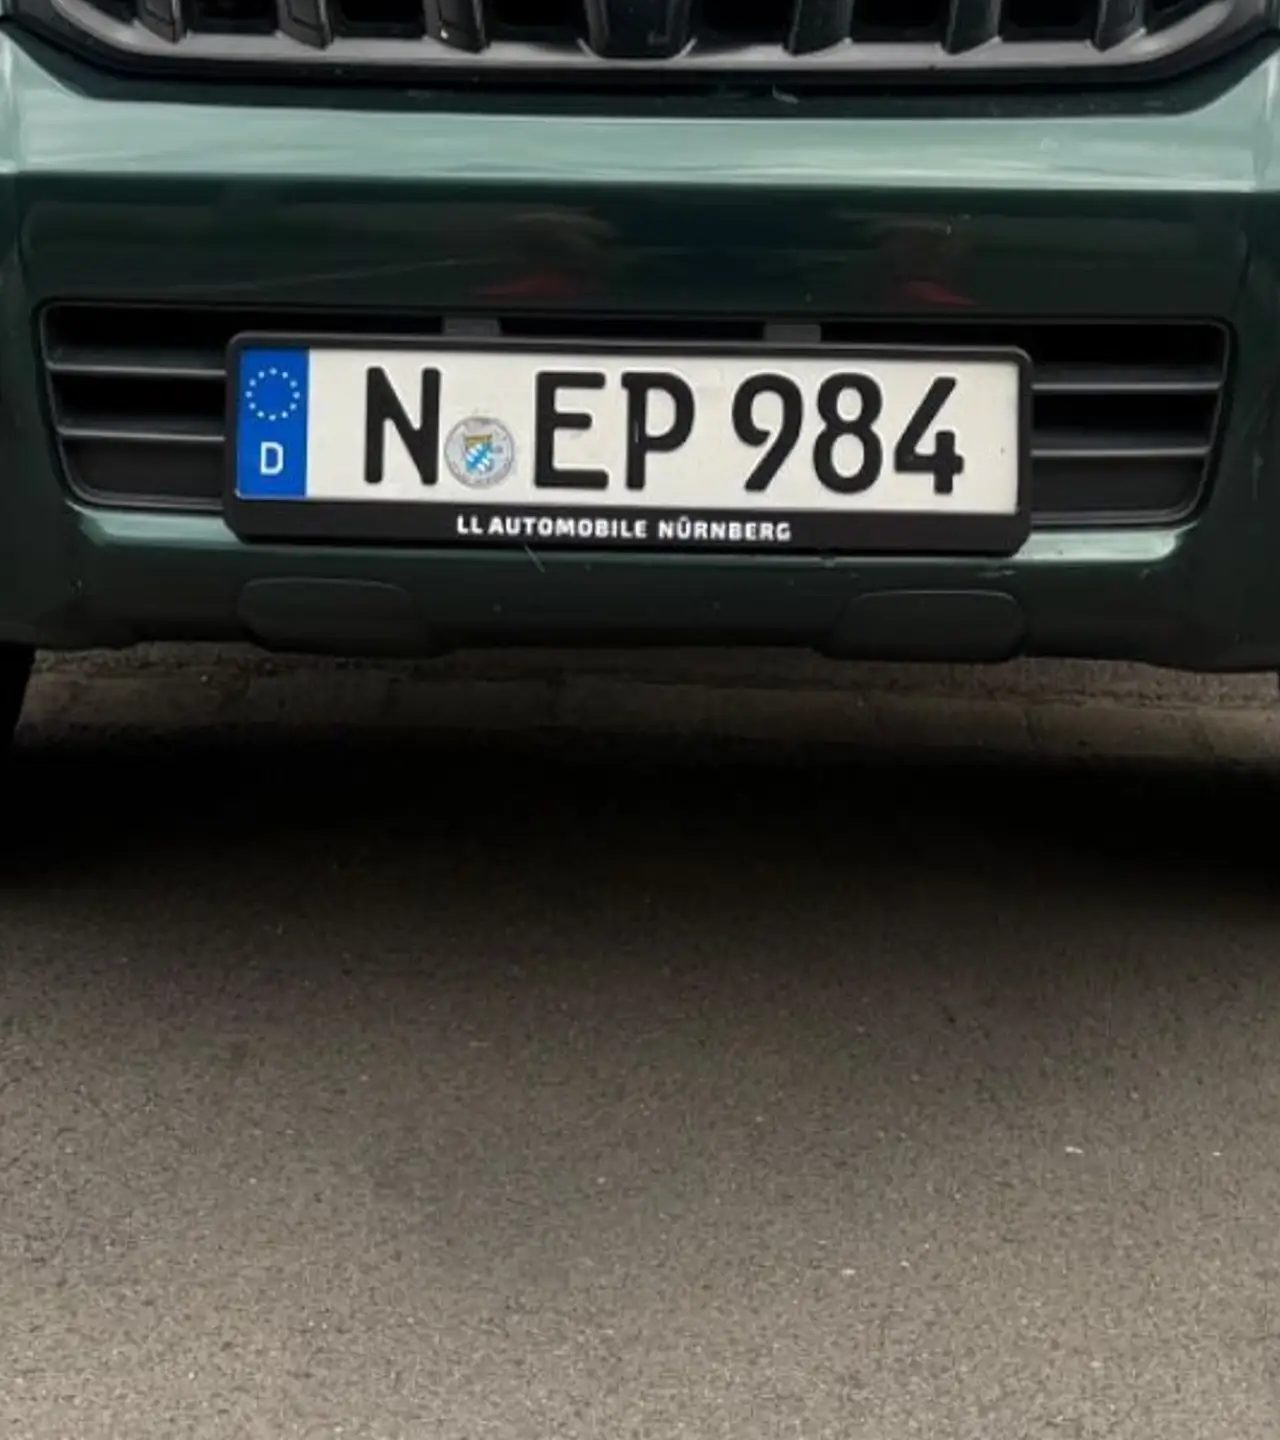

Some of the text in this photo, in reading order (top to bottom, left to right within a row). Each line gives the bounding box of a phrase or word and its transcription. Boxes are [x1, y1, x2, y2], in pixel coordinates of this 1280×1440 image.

[363, 366, 966, 496] N EP 984
[259, 441, 285, 476] D
[487, 516, 648, 539] AUTOMOBILE
[657, 515, 793, 542] NÜRNBERG
